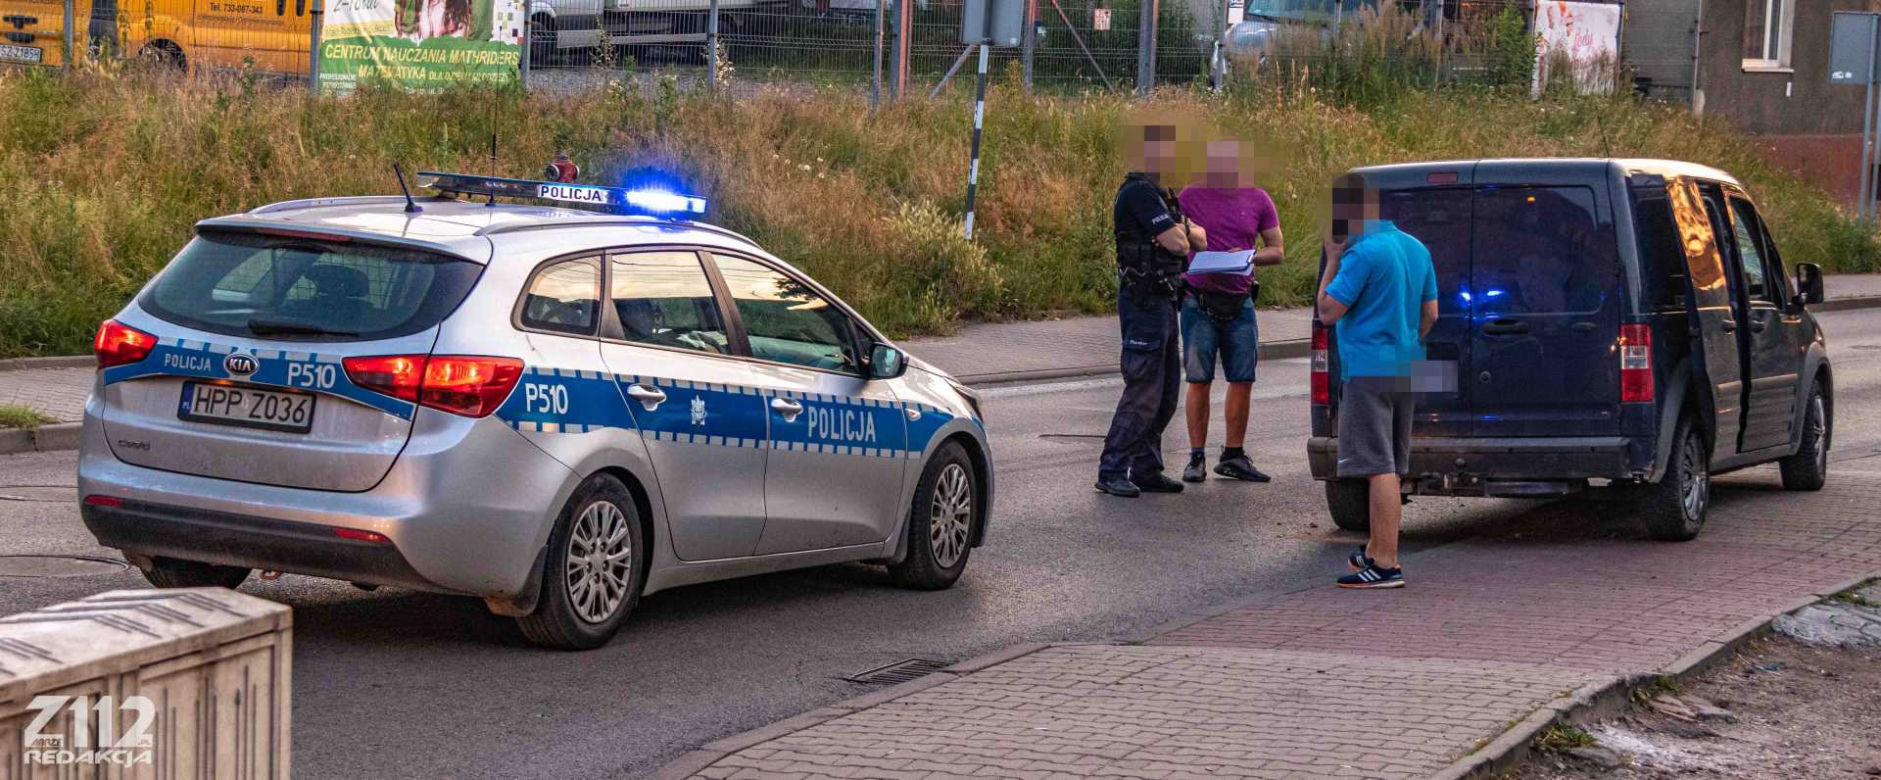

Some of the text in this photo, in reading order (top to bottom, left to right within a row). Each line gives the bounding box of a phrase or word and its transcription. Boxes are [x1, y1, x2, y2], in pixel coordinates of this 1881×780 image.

[325, 44, 520, 65] CENTRUM NAUCZANIA MATHRIDERS
[540, 185, 601, 201] POLICJA
[163, 352, 212, 372] POLICJA
[229, 358, 253, 371] KIA
[287, 362, 337, 389] P510
[194, 386, 308, 424] HPP Z036
[525, 382, 569, 415] P510
[807, 406, 877, 443] POLICJA
